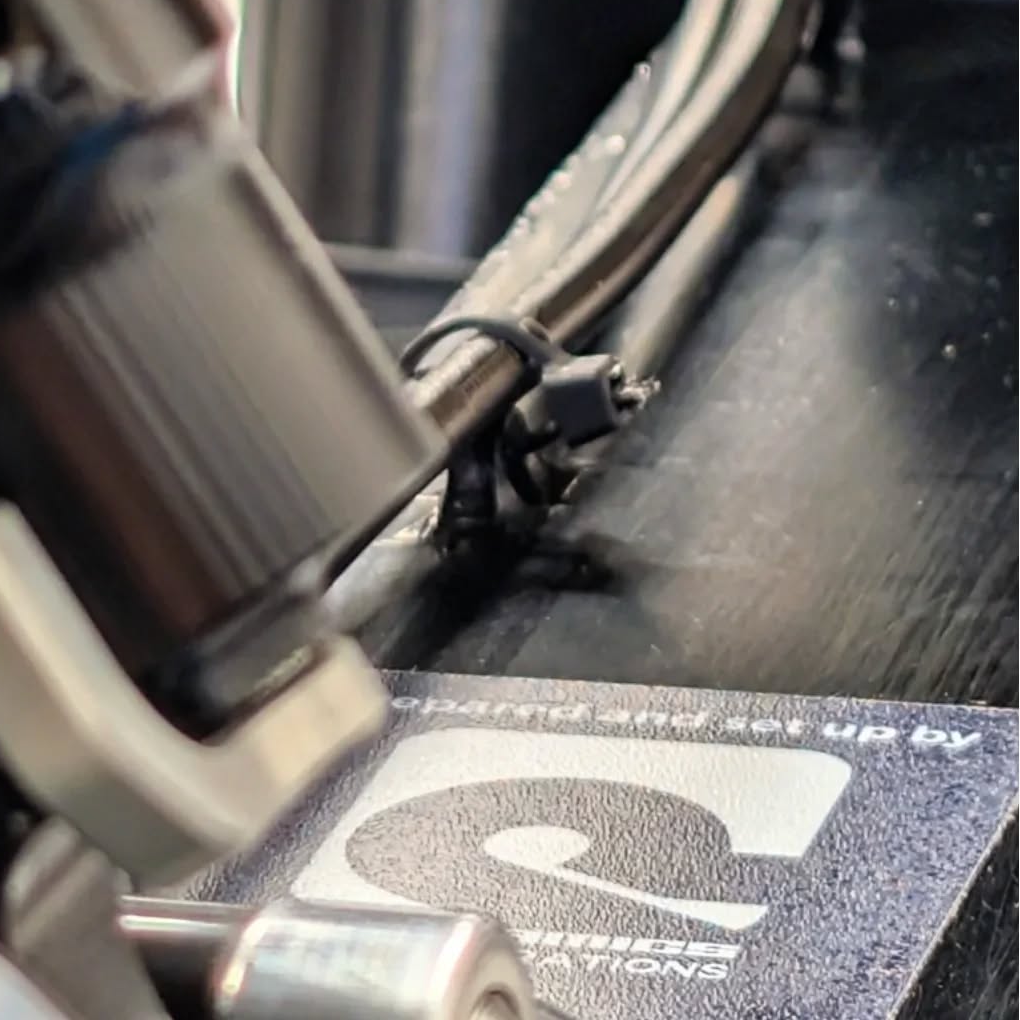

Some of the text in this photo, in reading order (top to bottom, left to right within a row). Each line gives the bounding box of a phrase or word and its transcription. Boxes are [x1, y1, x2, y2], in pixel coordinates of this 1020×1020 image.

[723, 714, 807, 736] set
[822, 720, 898, 744] up
[910, 724, 982, 750] by
